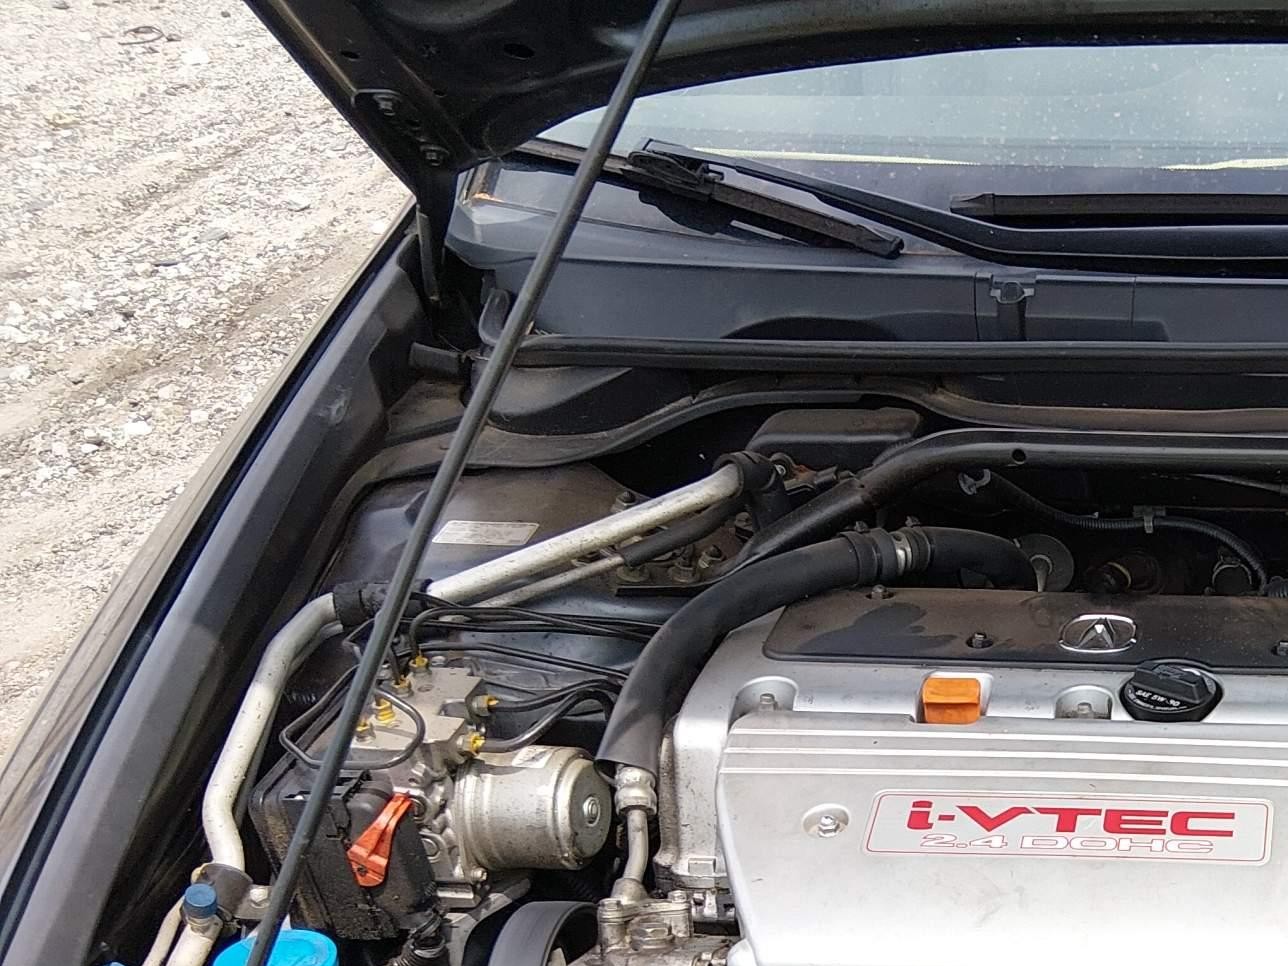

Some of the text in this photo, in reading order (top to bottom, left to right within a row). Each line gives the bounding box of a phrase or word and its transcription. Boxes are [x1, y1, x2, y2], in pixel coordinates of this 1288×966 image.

[907, 801, 1235, 837] i-VTEC
[920, 833, 1213, 853] 2.4 DOHC
